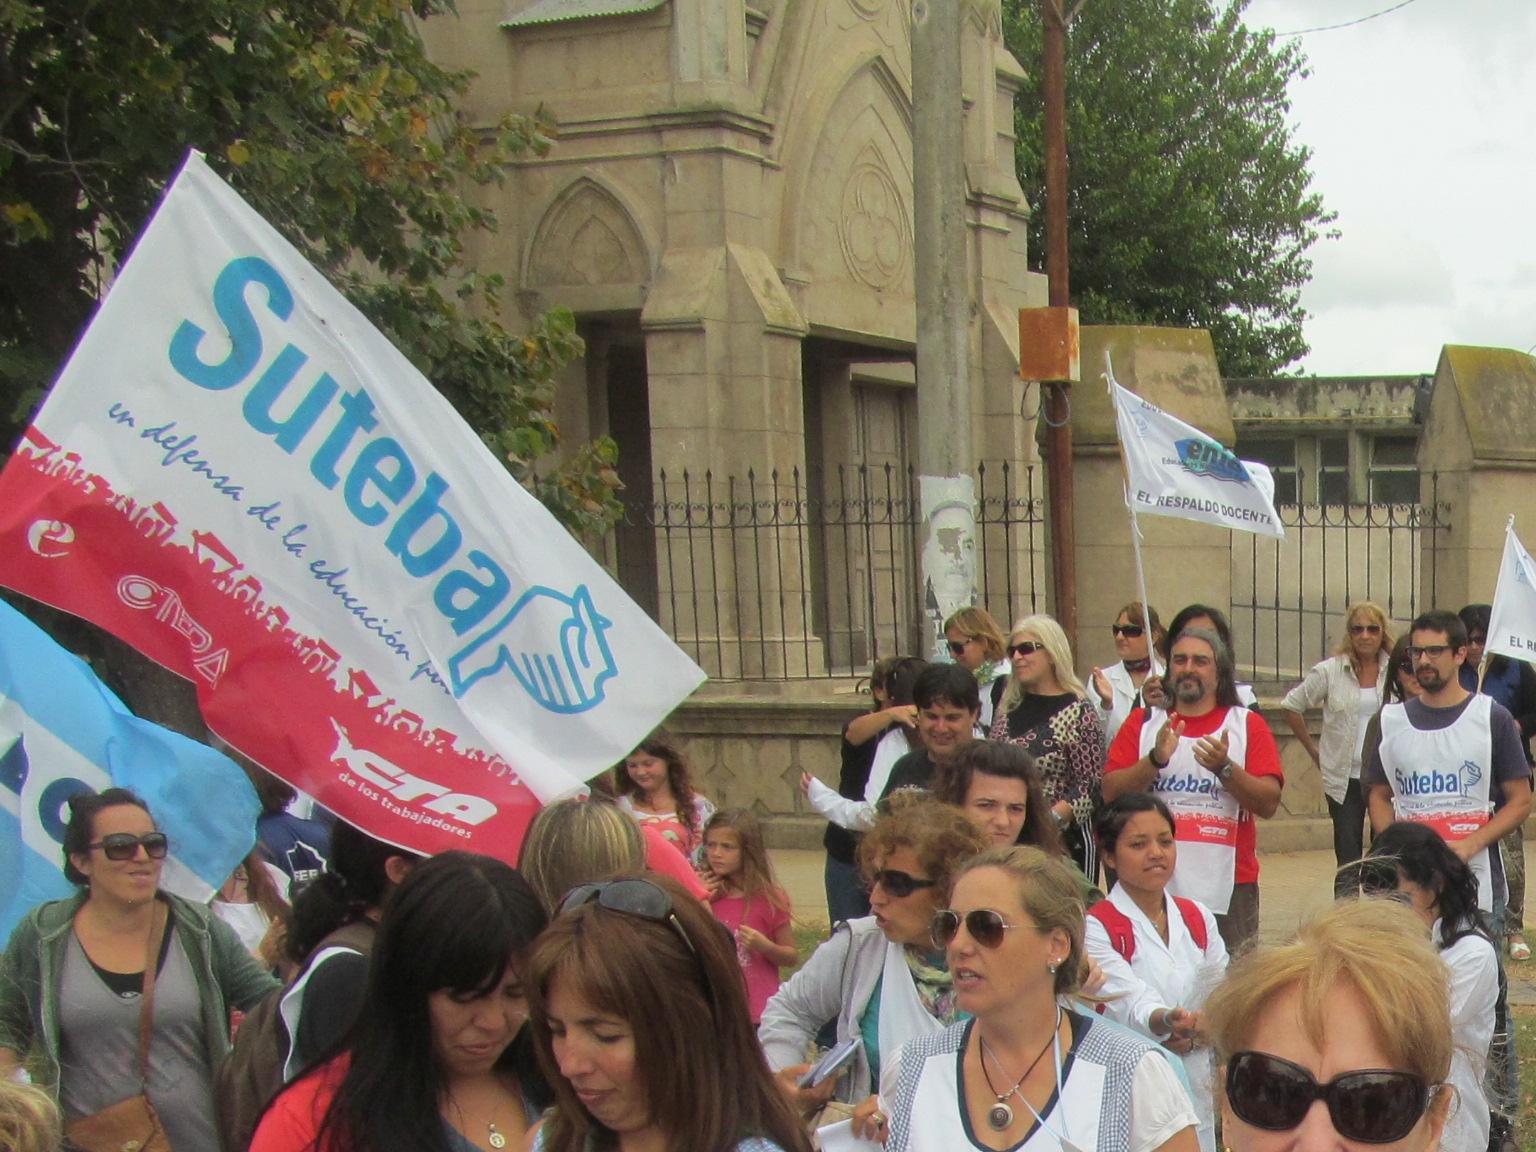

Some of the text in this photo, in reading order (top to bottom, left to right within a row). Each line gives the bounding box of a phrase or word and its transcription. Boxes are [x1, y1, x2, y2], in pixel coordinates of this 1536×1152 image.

[168, 255, 512, 638] Suteba
[108, 402, 411, 662] en defensa de la educación
[1137, 489, 1273, 525] EL RESPALDO DOCENTE
[1509, 635, 1523, 649] EL
[338, 772, 473, 839] de los trabajadores
[346, 749, 498, 826] CTA
[1395, 767, 1458, 796] Suteba
